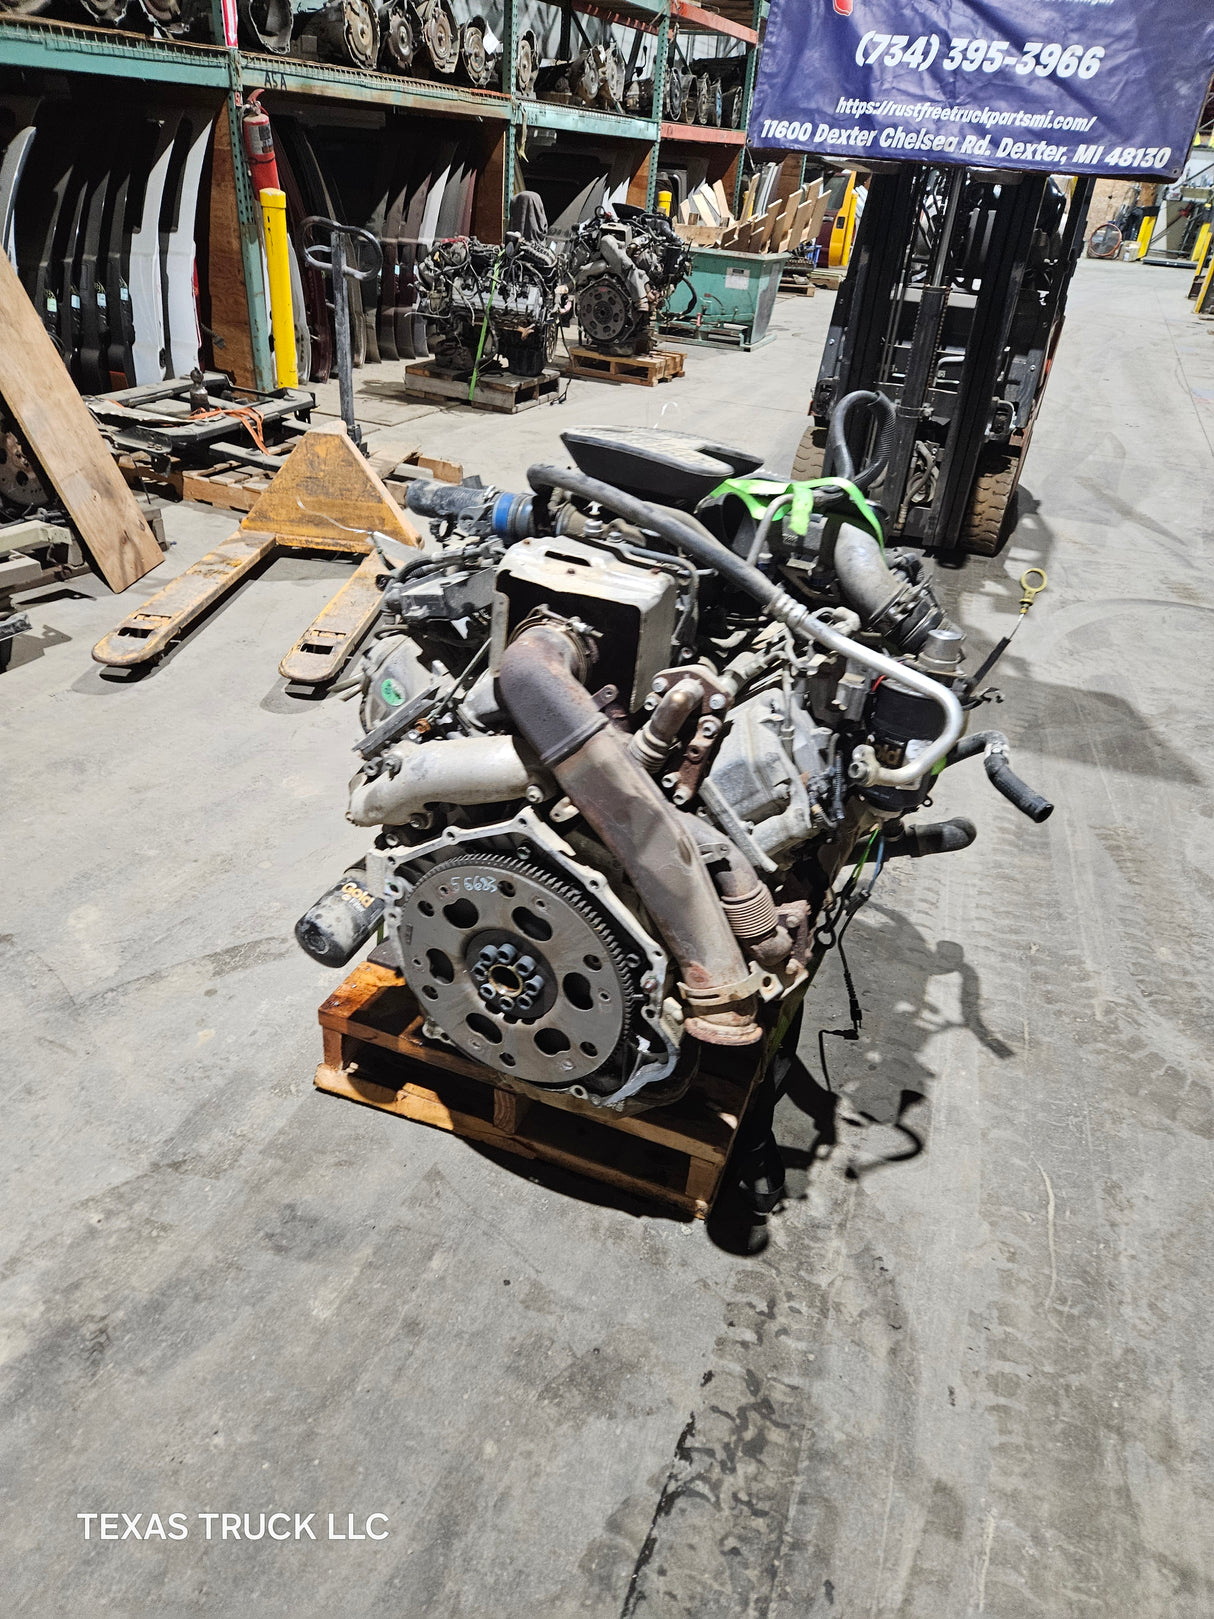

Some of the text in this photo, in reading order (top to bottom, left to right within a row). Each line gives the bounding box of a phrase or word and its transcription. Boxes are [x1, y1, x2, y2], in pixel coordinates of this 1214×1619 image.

[855, 30, 1105, 79] (734) 395-3966
[835, 97, 1098, 133] https://rustfreetruckpartsmi.com/
[760, 119, 1171, 169] 11600 Dexter Chelsea Rd. Dexter, MI 48130
